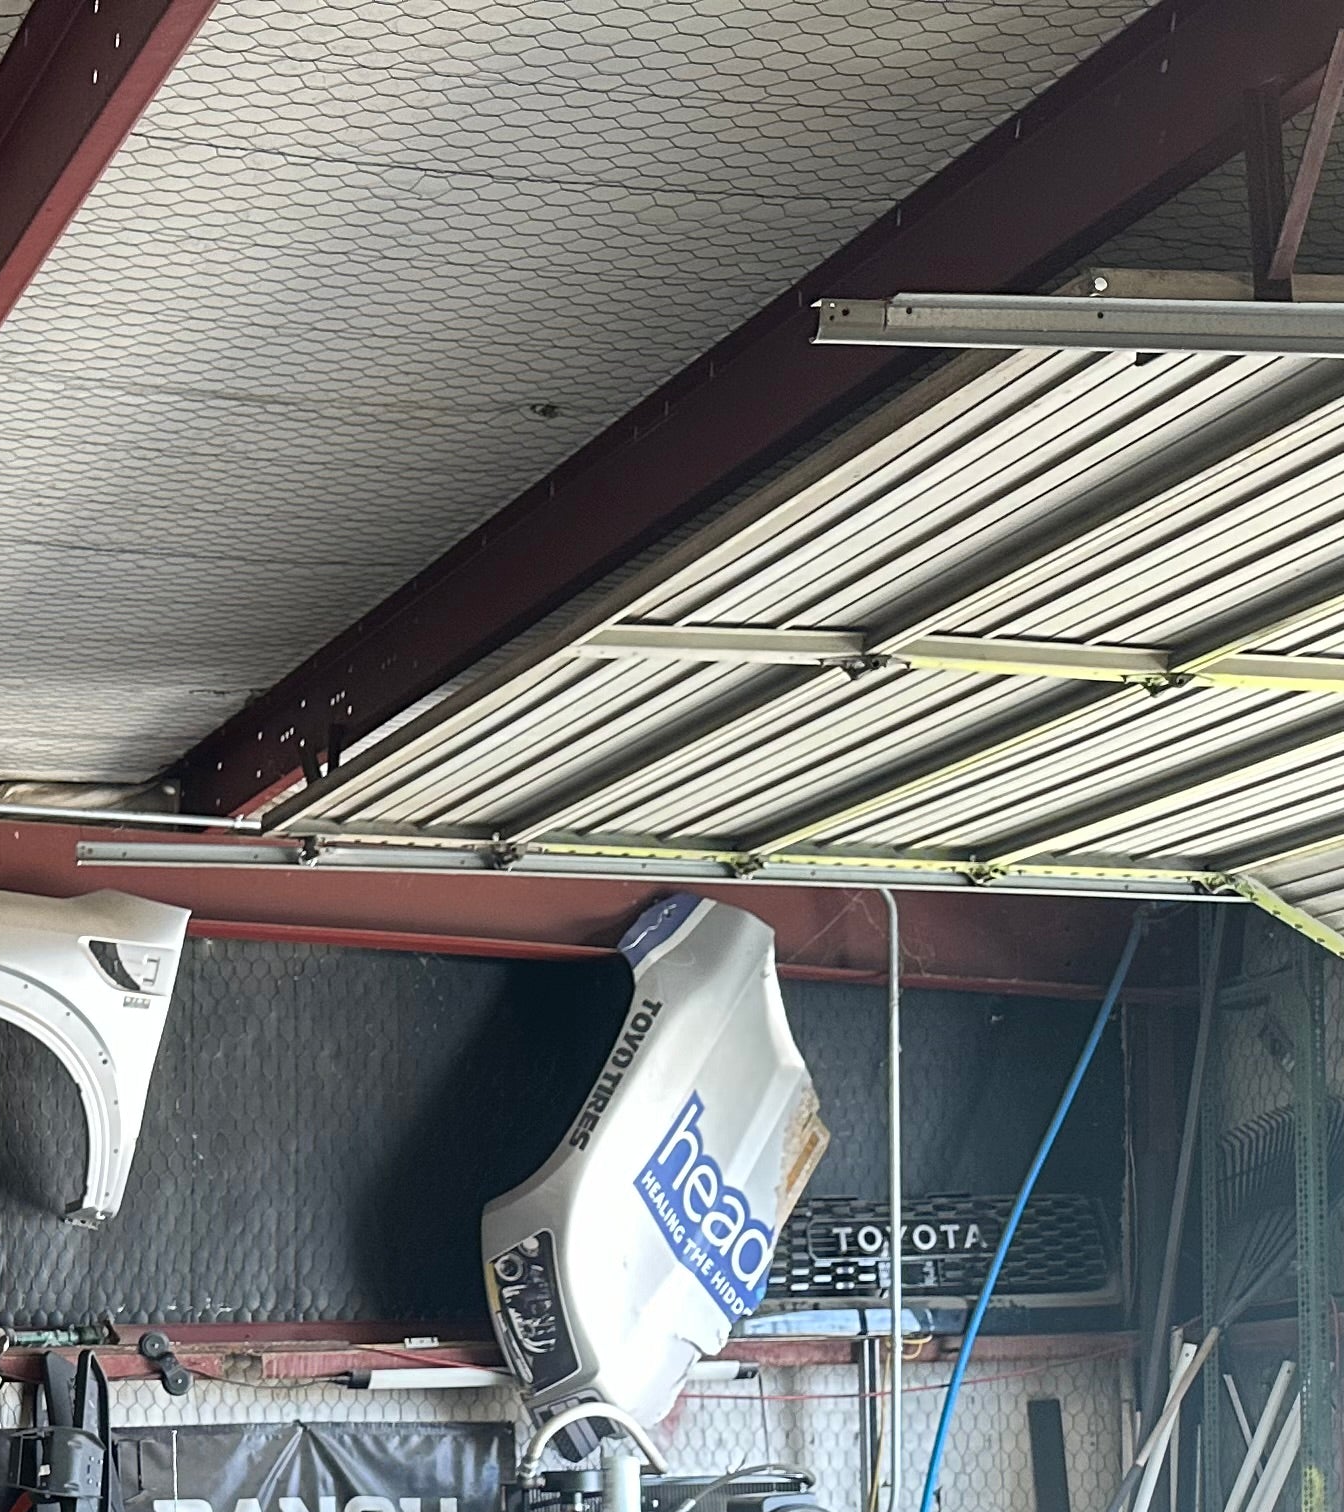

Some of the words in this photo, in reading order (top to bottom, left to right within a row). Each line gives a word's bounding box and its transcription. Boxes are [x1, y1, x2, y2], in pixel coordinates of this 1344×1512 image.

[613, 999, 663, 1068] TOYO
[569, 1072, 624, 1151] TIRES
[642, 1170, 686, 1244] HEALING
[683, 1237, 715, 1276] THE
